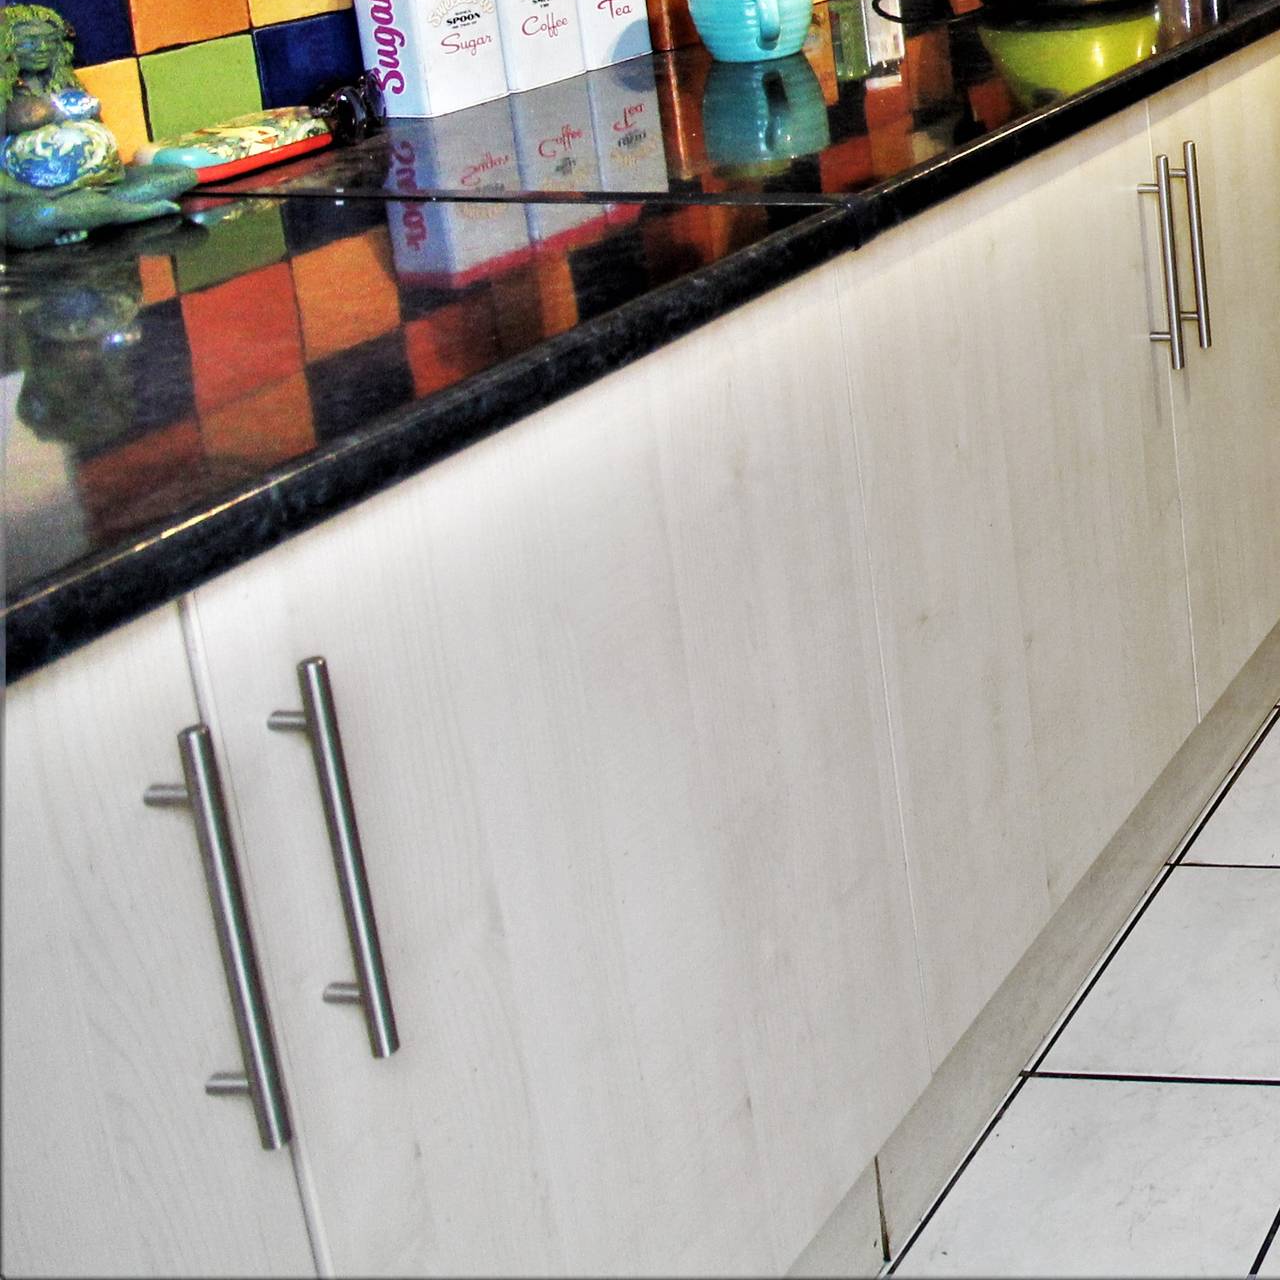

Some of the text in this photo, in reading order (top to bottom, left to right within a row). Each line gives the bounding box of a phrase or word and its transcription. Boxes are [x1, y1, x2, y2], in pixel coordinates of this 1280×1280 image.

[446, 12, 481, 25] SPOON
[521, 12, 569, 38] Coffee
[440, 32, 493, 56] Sugar
